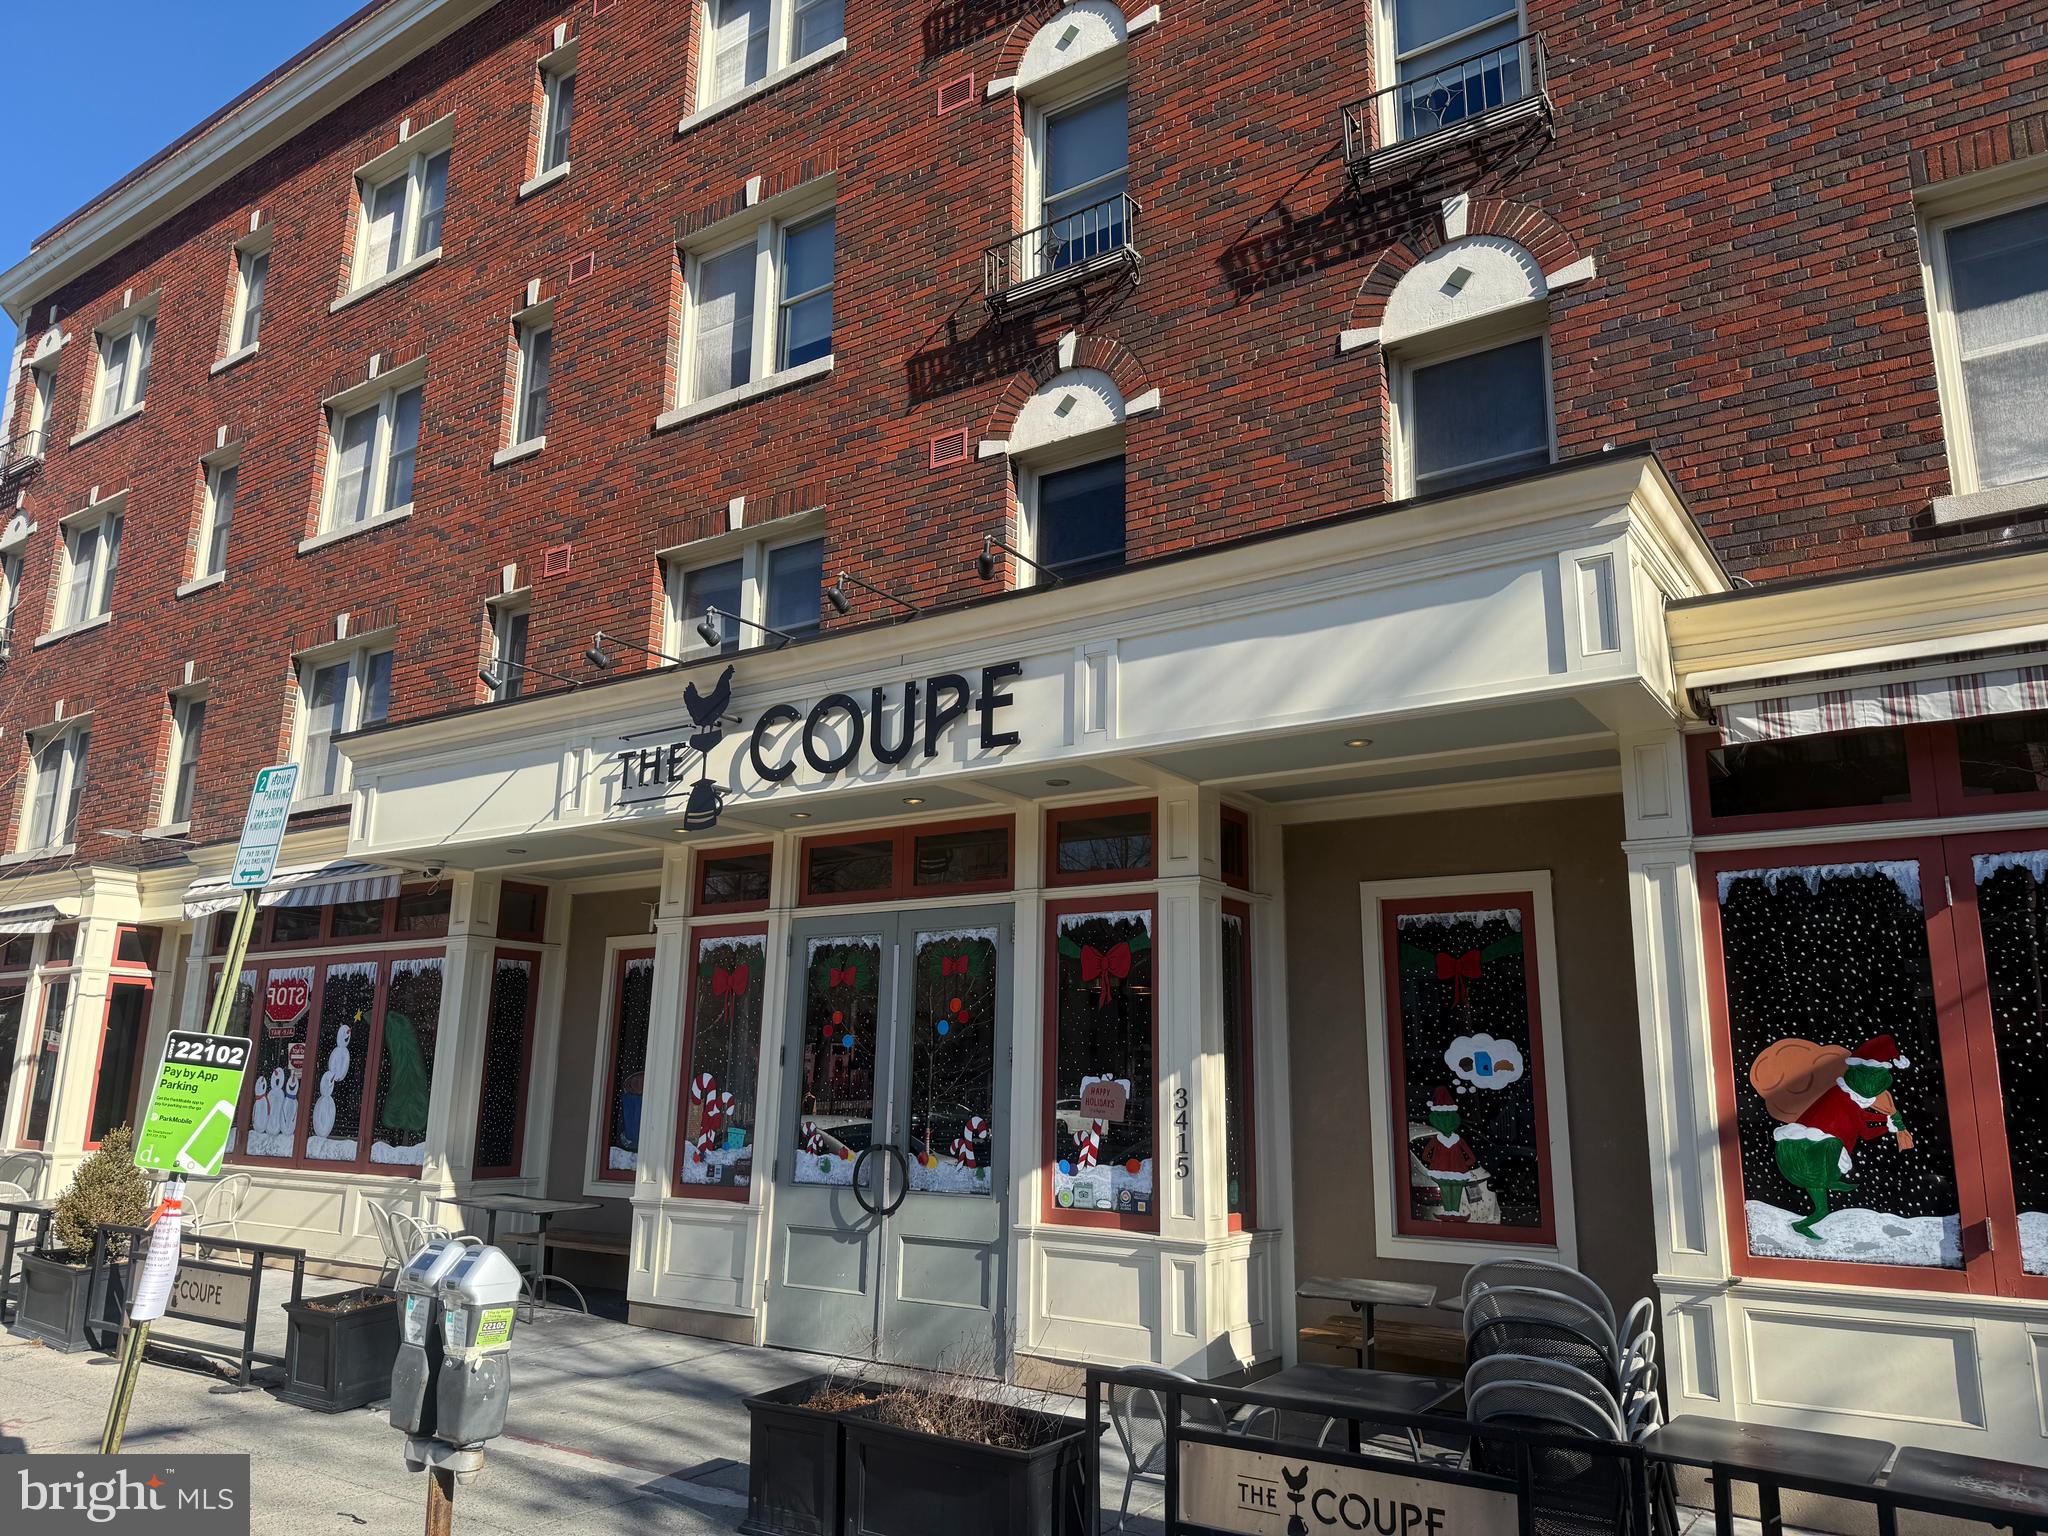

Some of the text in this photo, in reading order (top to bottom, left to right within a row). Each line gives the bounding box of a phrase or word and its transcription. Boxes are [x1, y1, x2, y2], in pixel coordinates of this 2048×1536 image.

[617, 661, 1021, 789] THE COUPE
[259, 774, 291, 791] 2 HOUR
[264, 787, 291, 800] PARKING
[174, 1041, 244, 1065] 22102
[163, 1066, 218, 1082] Pay by App
[160, 1079, 198, 1094] Parking
[1091, 1087, 1110, 1096] HAPPY
[1085, 1097, 1115, 1108] HOLIDAYS
[159, 1114, 192, 1125] ParkMobile
[1175, 1087, 1189, 1178] 3415
[180, 1280, 223, 1305] COUPE
[483, 1321, 506, 1330] 22102
[1237, 1482, 1446, 1536] THE COUPE
